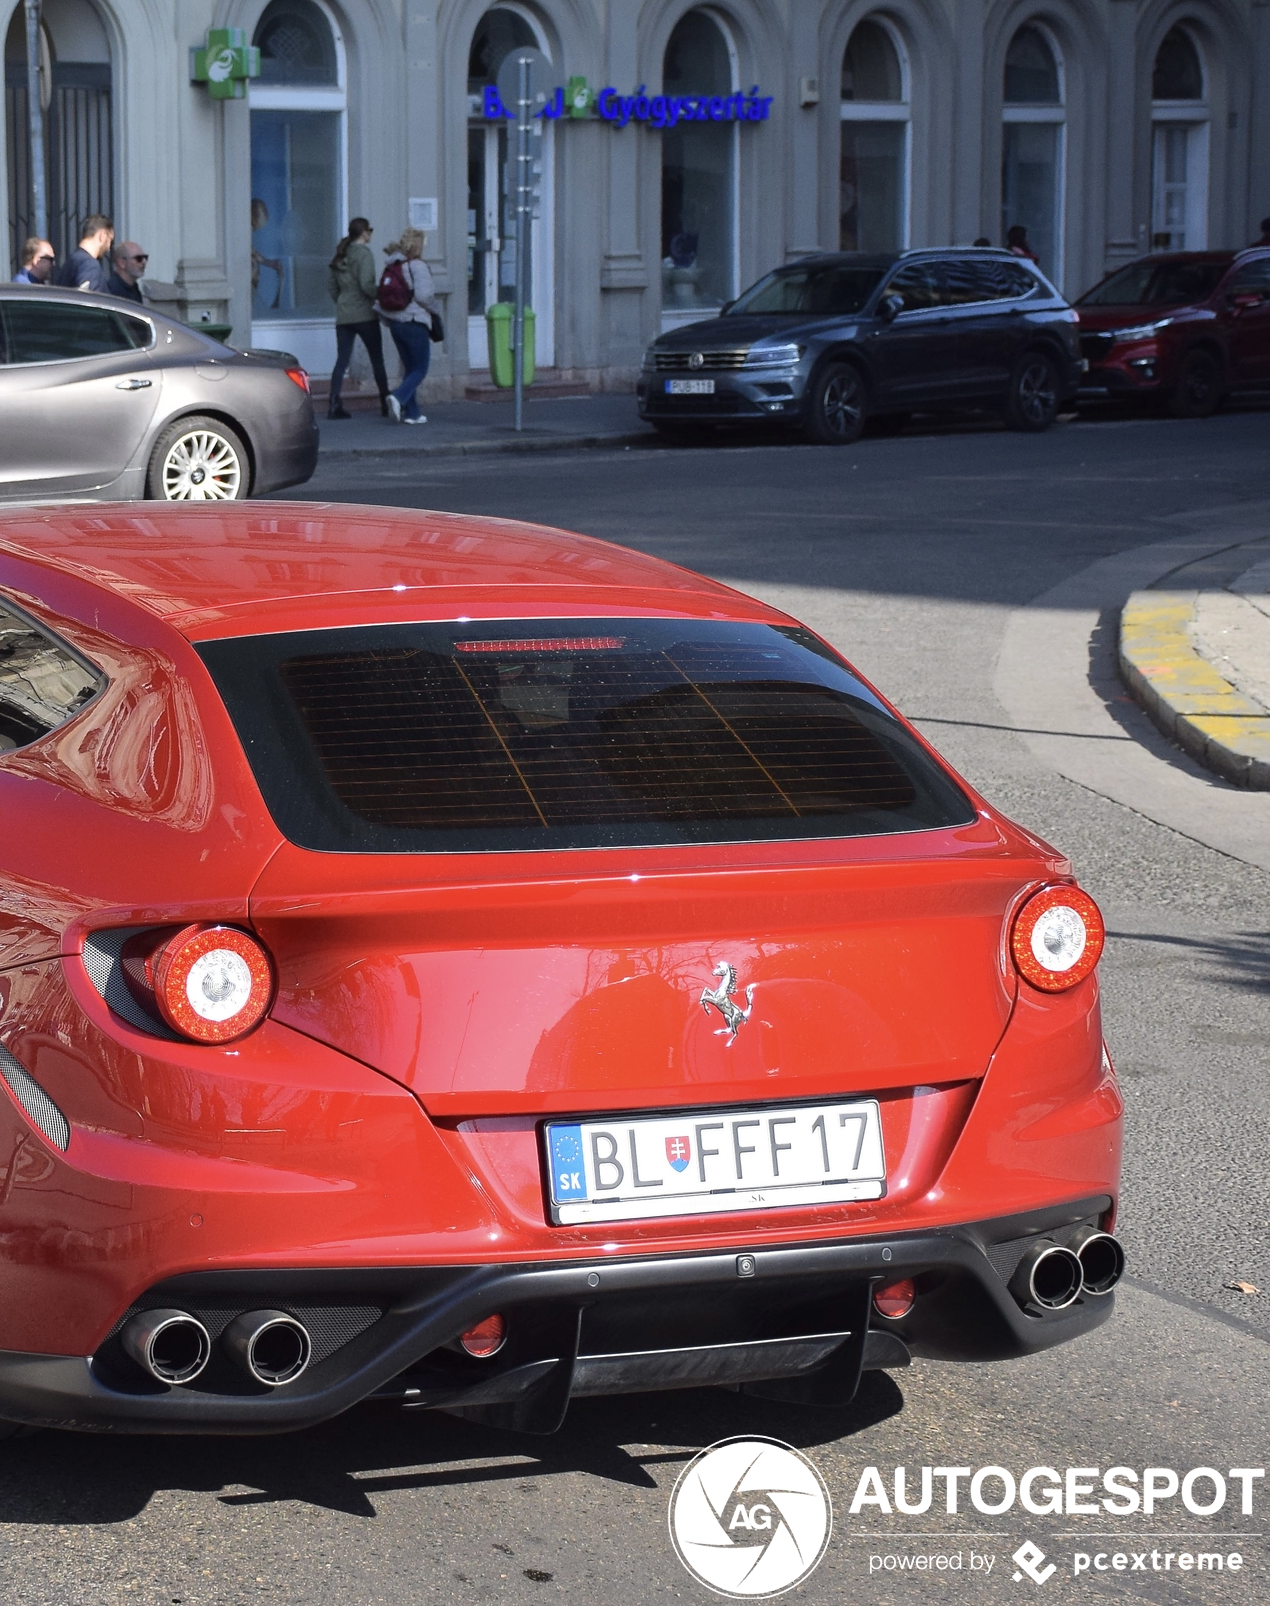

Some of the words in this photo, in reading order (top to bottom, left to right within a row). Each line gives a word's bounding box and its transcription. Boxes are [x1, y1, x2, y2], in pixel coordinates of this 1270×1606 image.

[597, 84, 773, 128] Gyógyszertár
[590, 1128, 664, 1191] BL
[559, 1173, 582, 1192] SK
